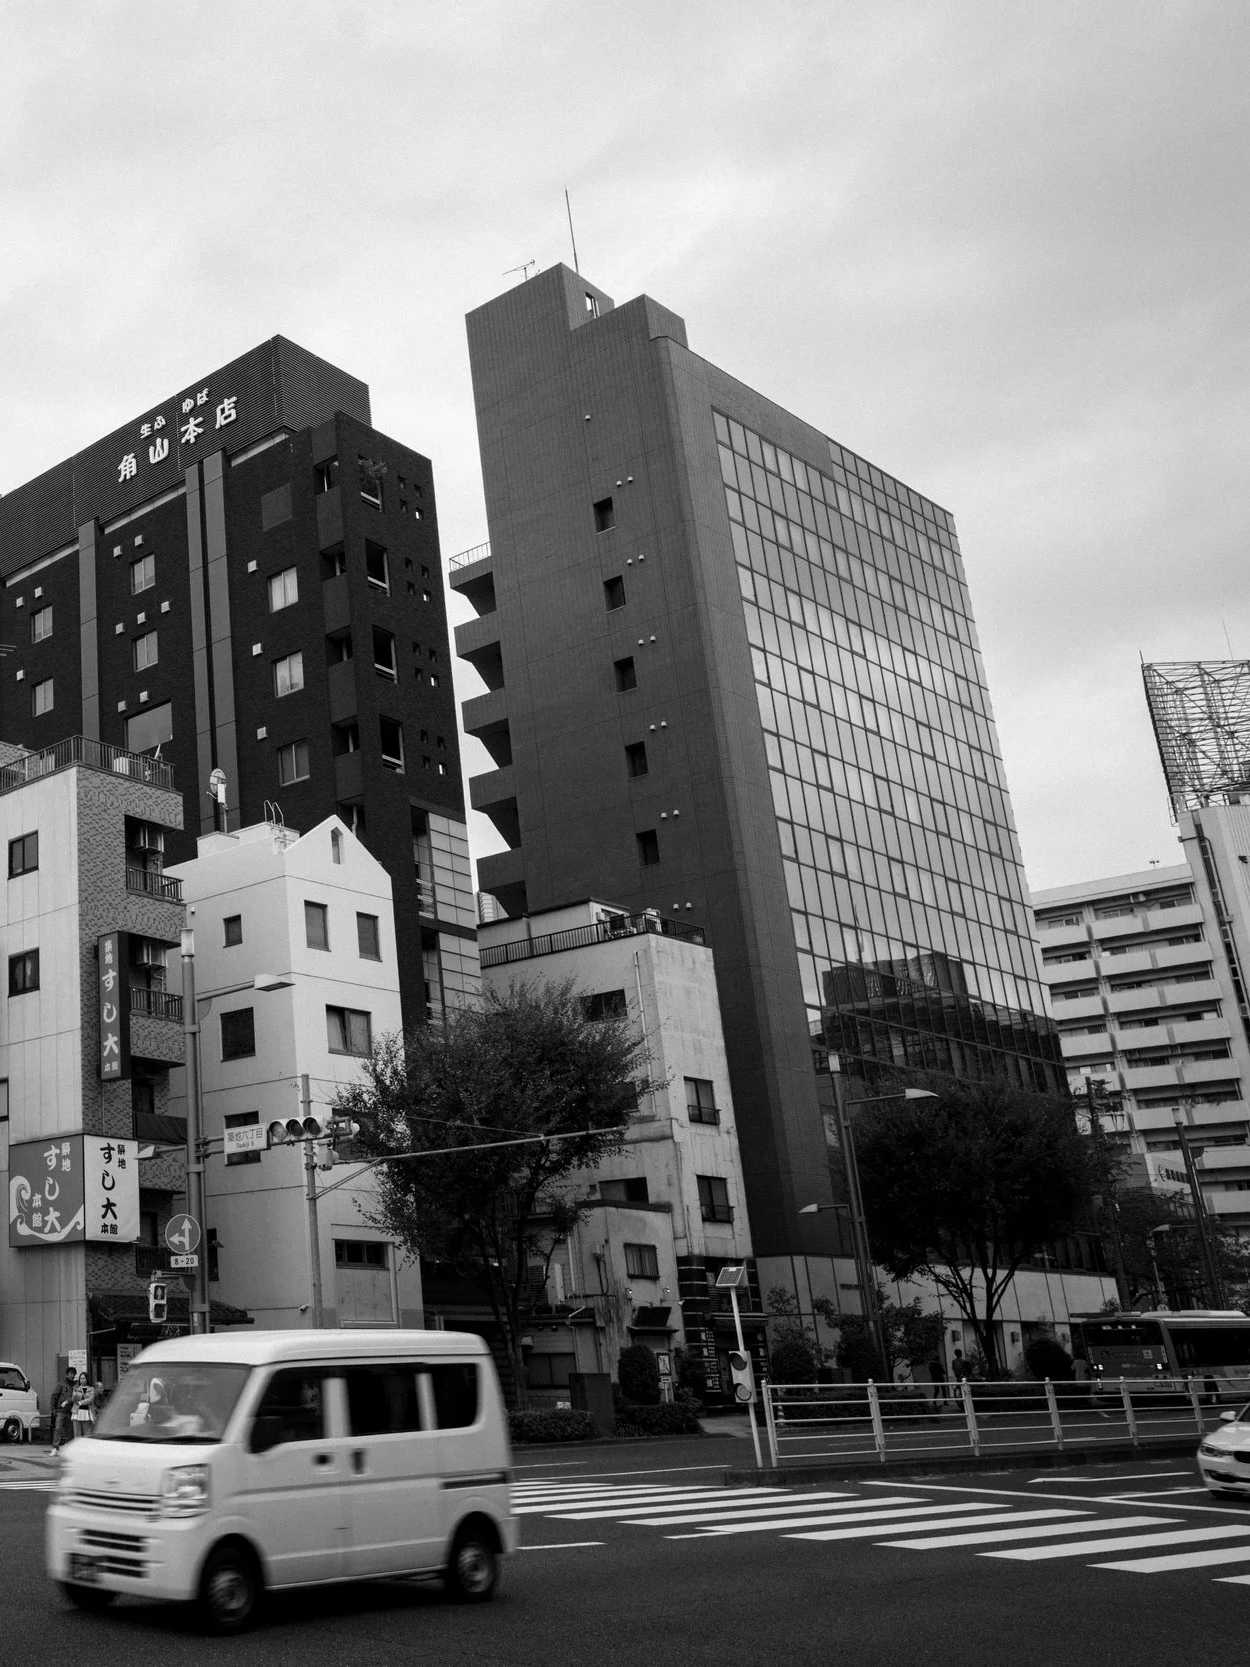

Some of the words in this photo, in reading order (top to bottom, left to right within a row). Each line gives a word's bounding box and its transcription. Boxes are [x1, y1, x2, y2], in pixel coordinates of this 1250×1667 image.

[182, 388, 209, 413] ゆば
[118, 396, 237, 482] 角山本店
[104, 939, 113, 965] 築地
[102, 968, 119, 1057] すし大
[104, 1061, 118, 1072] 本館
[227, 1127, 262, 1143] 築地六丁目
[61, 1142, 71, 1172] 築地
[117, 1144, 126, 1170] 築地
[43, 1145, 61, 1233] すし大
[100, 1143, 118, 1220] すし大
[32, 1193, 42, 1228] 本館
[100, 1223, 118, 1235] 本館
[174, 1257, 194, 1266] 8-20
